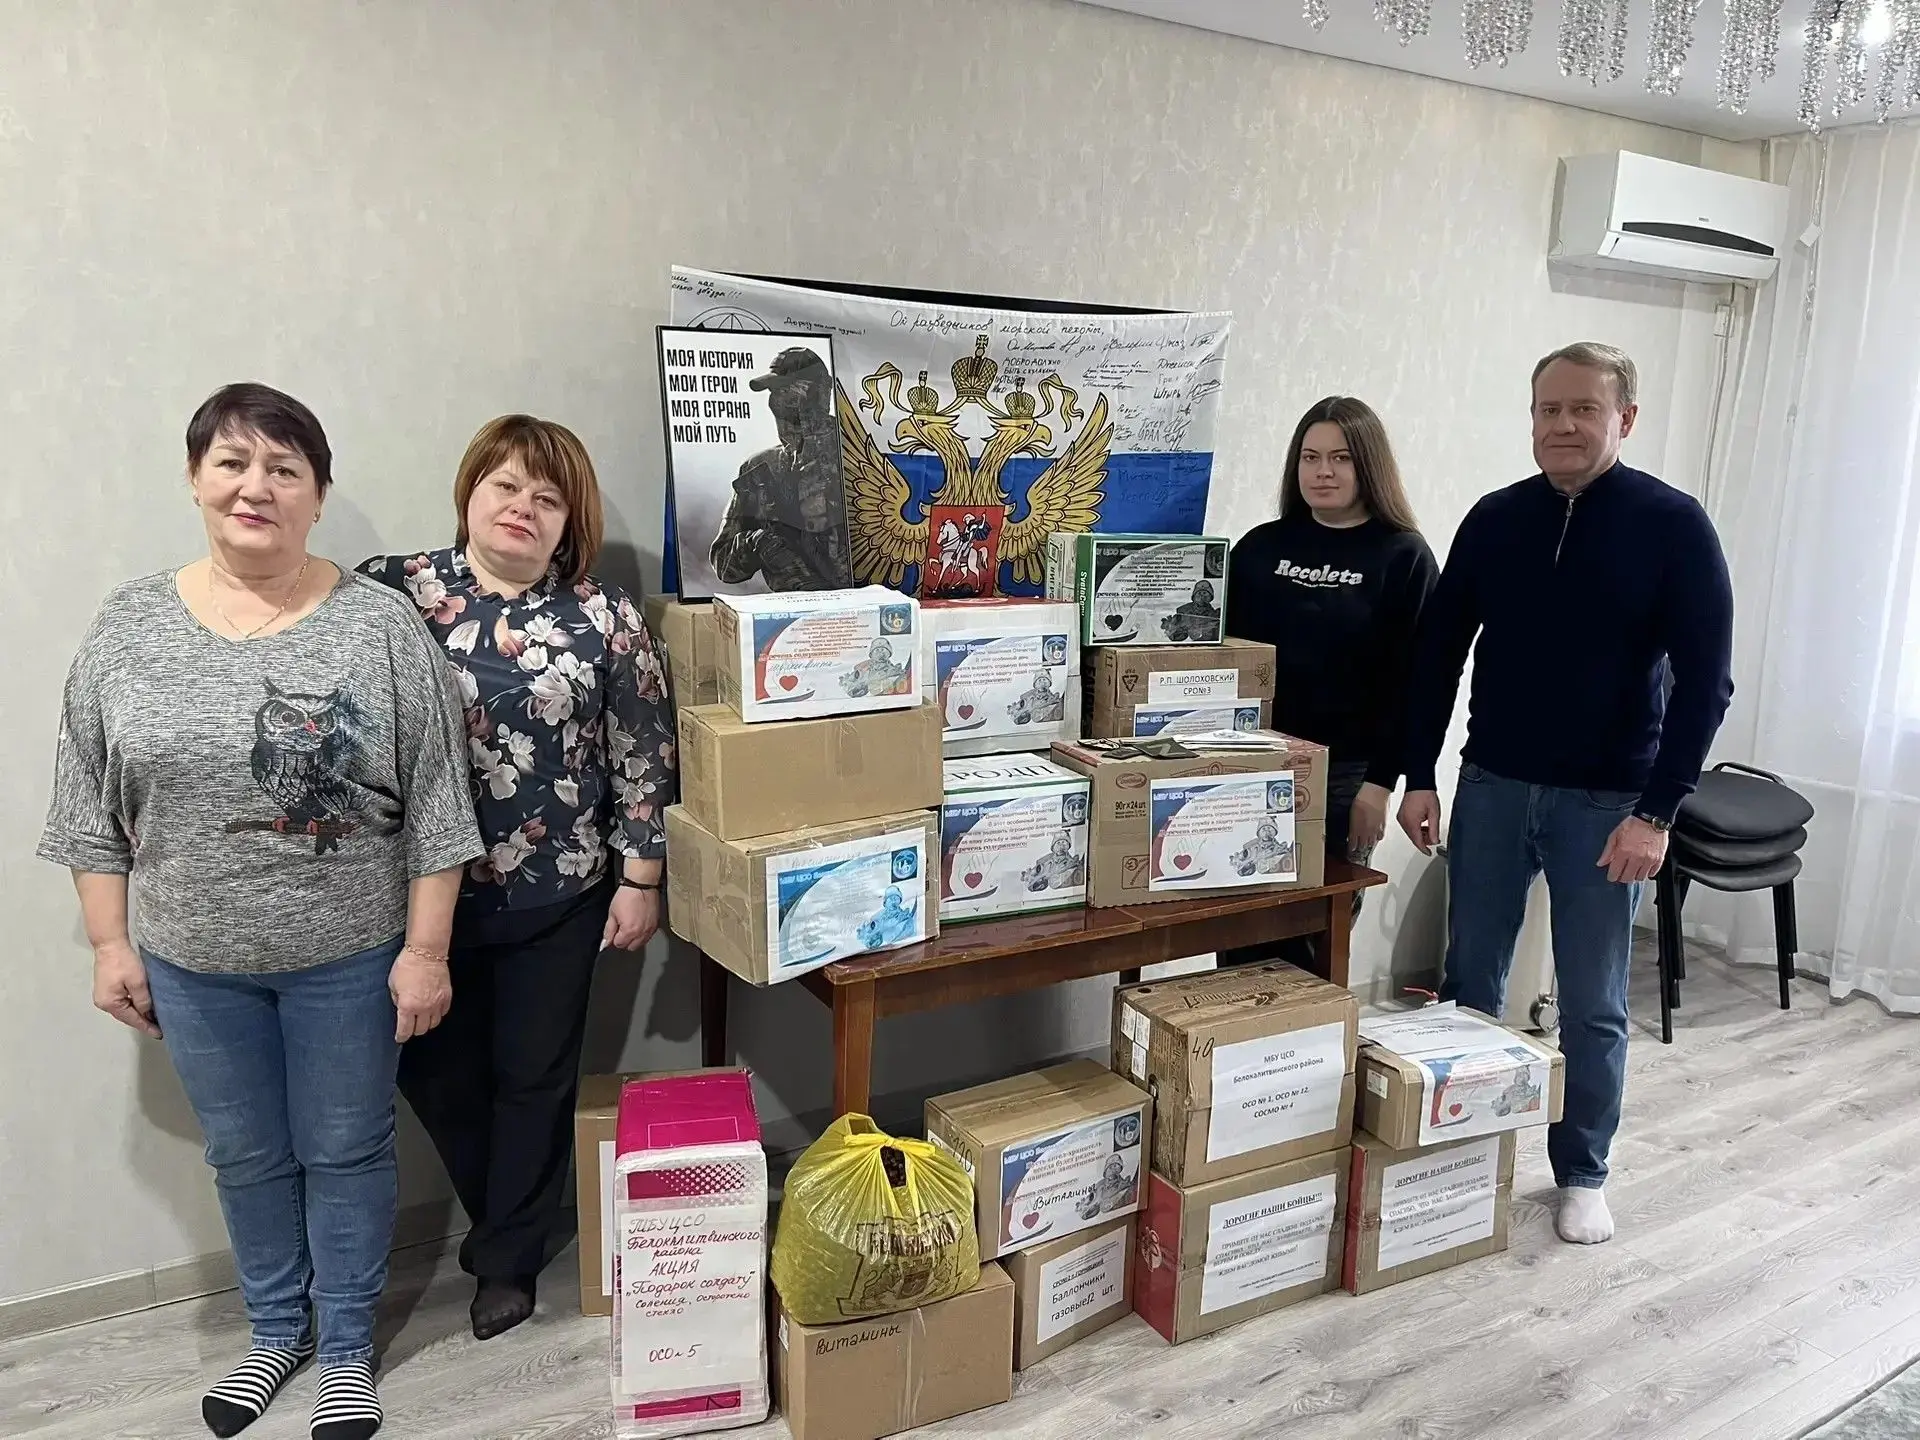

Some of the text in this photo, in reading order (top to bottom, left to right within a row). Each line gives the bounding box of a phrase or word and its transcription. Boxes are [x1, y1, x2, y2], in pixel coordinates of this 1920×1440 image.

[666, 349, 755, 370] МОЯ ИСТОРИЯ
[669, 374, 739, 394] МОИ ГЕРОИ
[671, 400, 752, 420] МОЯ СТРАНА
[673, 421, 737, 444] МОЙ ПУТЬ
[1274, 560, 1363, 585] Recoleta
[1176, 673, 1235, 684] ШОЛОХОВСКИЙ
[1191, 1036, 1215, 1061] 40
[1263, 1050, 1295, 1065] МБУ ЦСО
[1233, 1057, 1324, 1084] Белокалитвинского района
[1242, 1099, 1258, 1110] ОСО
[1275, 1091, 1291, 1101] ОСО
[1254, 1105, 1280, 1119] СОСМО
[1223, 1210, 1260, 1229] ДОРОГИЕ
[1260, 1200, 1286, 1216] НАШИ
[652, 1246, 704, 1261] района
[648, 1259, 700, 1280] АКЦИЯ
[1052, 1272, 1106, 1304] Баллончики
[1102, 1283, 1116, 1296] шт.
[648, 1346, 674, 1363] ОСО
[686, 1343, 703, 1358] 5
